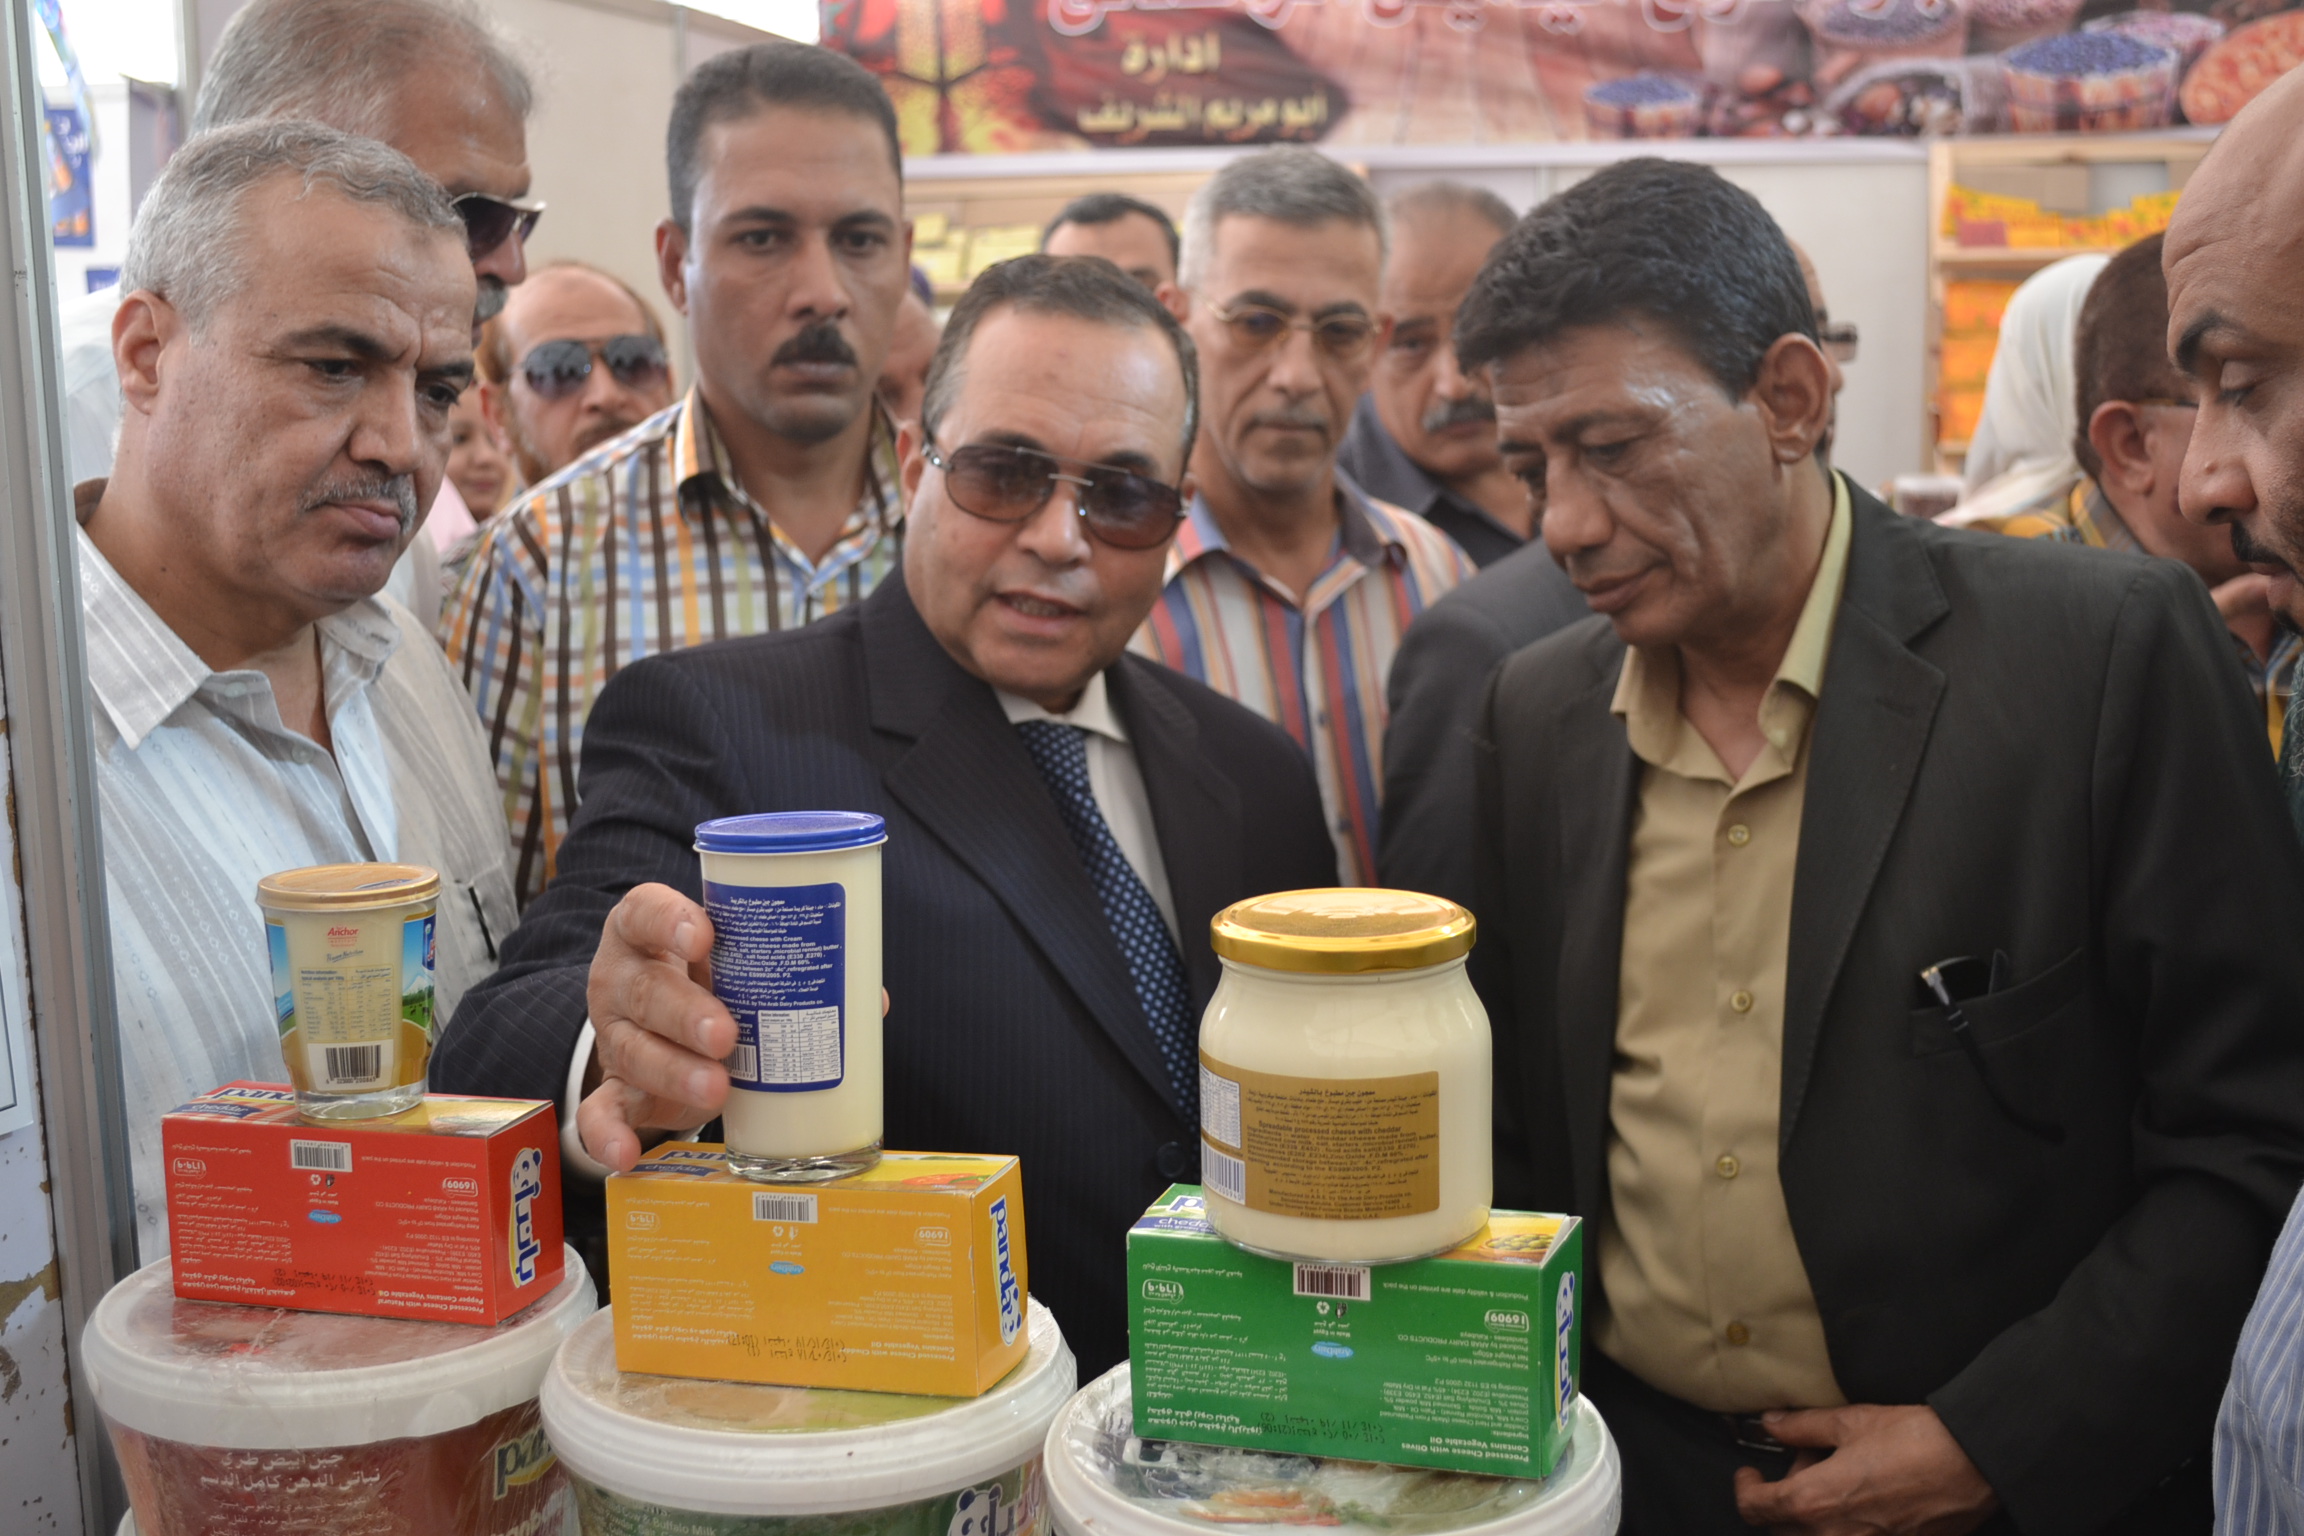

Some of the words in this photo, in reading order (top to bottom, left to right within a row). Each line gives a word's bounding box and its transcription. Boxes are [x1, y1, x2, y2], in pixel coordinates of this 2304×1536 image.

[327, 927, 359, 936] Anchor
[192, 1104, 248, 1112] cheddar
[645, 1164, 704, 1172] cheddar
[447, 1180, 474, 1189] 16909
[514, 1183, 540, 1285] باندا
[919, 1230, 948, 1239] 16909
[989, 1197, 1016, 1318] panda
[1419, 1284, 1440, 1292] printed
[1467, 1288, 1488, 1296] validity
[391, 1290, 425, 1300] Vegetable
[427, 1294, 457, 1302] Contains
[459, 1295, 483, 1304] Pepper
[1496, 1291, 1528, 1299] Production
[378, 1299, 404, 1307] Natural
[424, 1302, 448, 1310] Cheese
[450, 1305, 484, 1313] Processed
[1490, 1313, 1525, 1325] 16909
[1313, 1329, 1329, 1337] Egypt
[1410, 1335, 1447, 1344] PRODUCTS
[884, 1341, 920, 1350] Vegetable
[1499, 1343, 1528, 1351] Produced
[918, 1353, 955, 1361] Processed
[1495, 1351, 1516, 1359] Weight
[1474, 1358, 1511, 1368] Refrigerated
[1194, 1411, 1214, 1420] زيوت
[1216, 1413, 1240, 1423] نباتية
[1261, 1412, 1275, 1422] (2)
[1148, 1417, 1177, 1427] معجون
[1179, 1420, 1196, 1428] جبن
[1199, 1422, 1226, 1431] مطبوخ
[1452, 1418, 1474, 1426] Cheese
[1430, 1436, 1443, 1444] Oil
[1445, 1436, 1488, 1449] Vegetable
[1402, 1443, 1428, 1452] Olives
[1430, 1445, 1450, 1454] with
[1490, 1442, 1529, 1452] Contains
[1452, 1448, 1483, 1457] Cheese
[1486, 1451, 1529, 1462] Processed
[309, 1453, 344, 1469] جبن
[243, 1474, 282, 1492] كامل
[286, 1474, 334, 1493] الدهن
[653, 1517, 689, 1533] Buffalo
[692, 1524, 717, 1536] Milk
